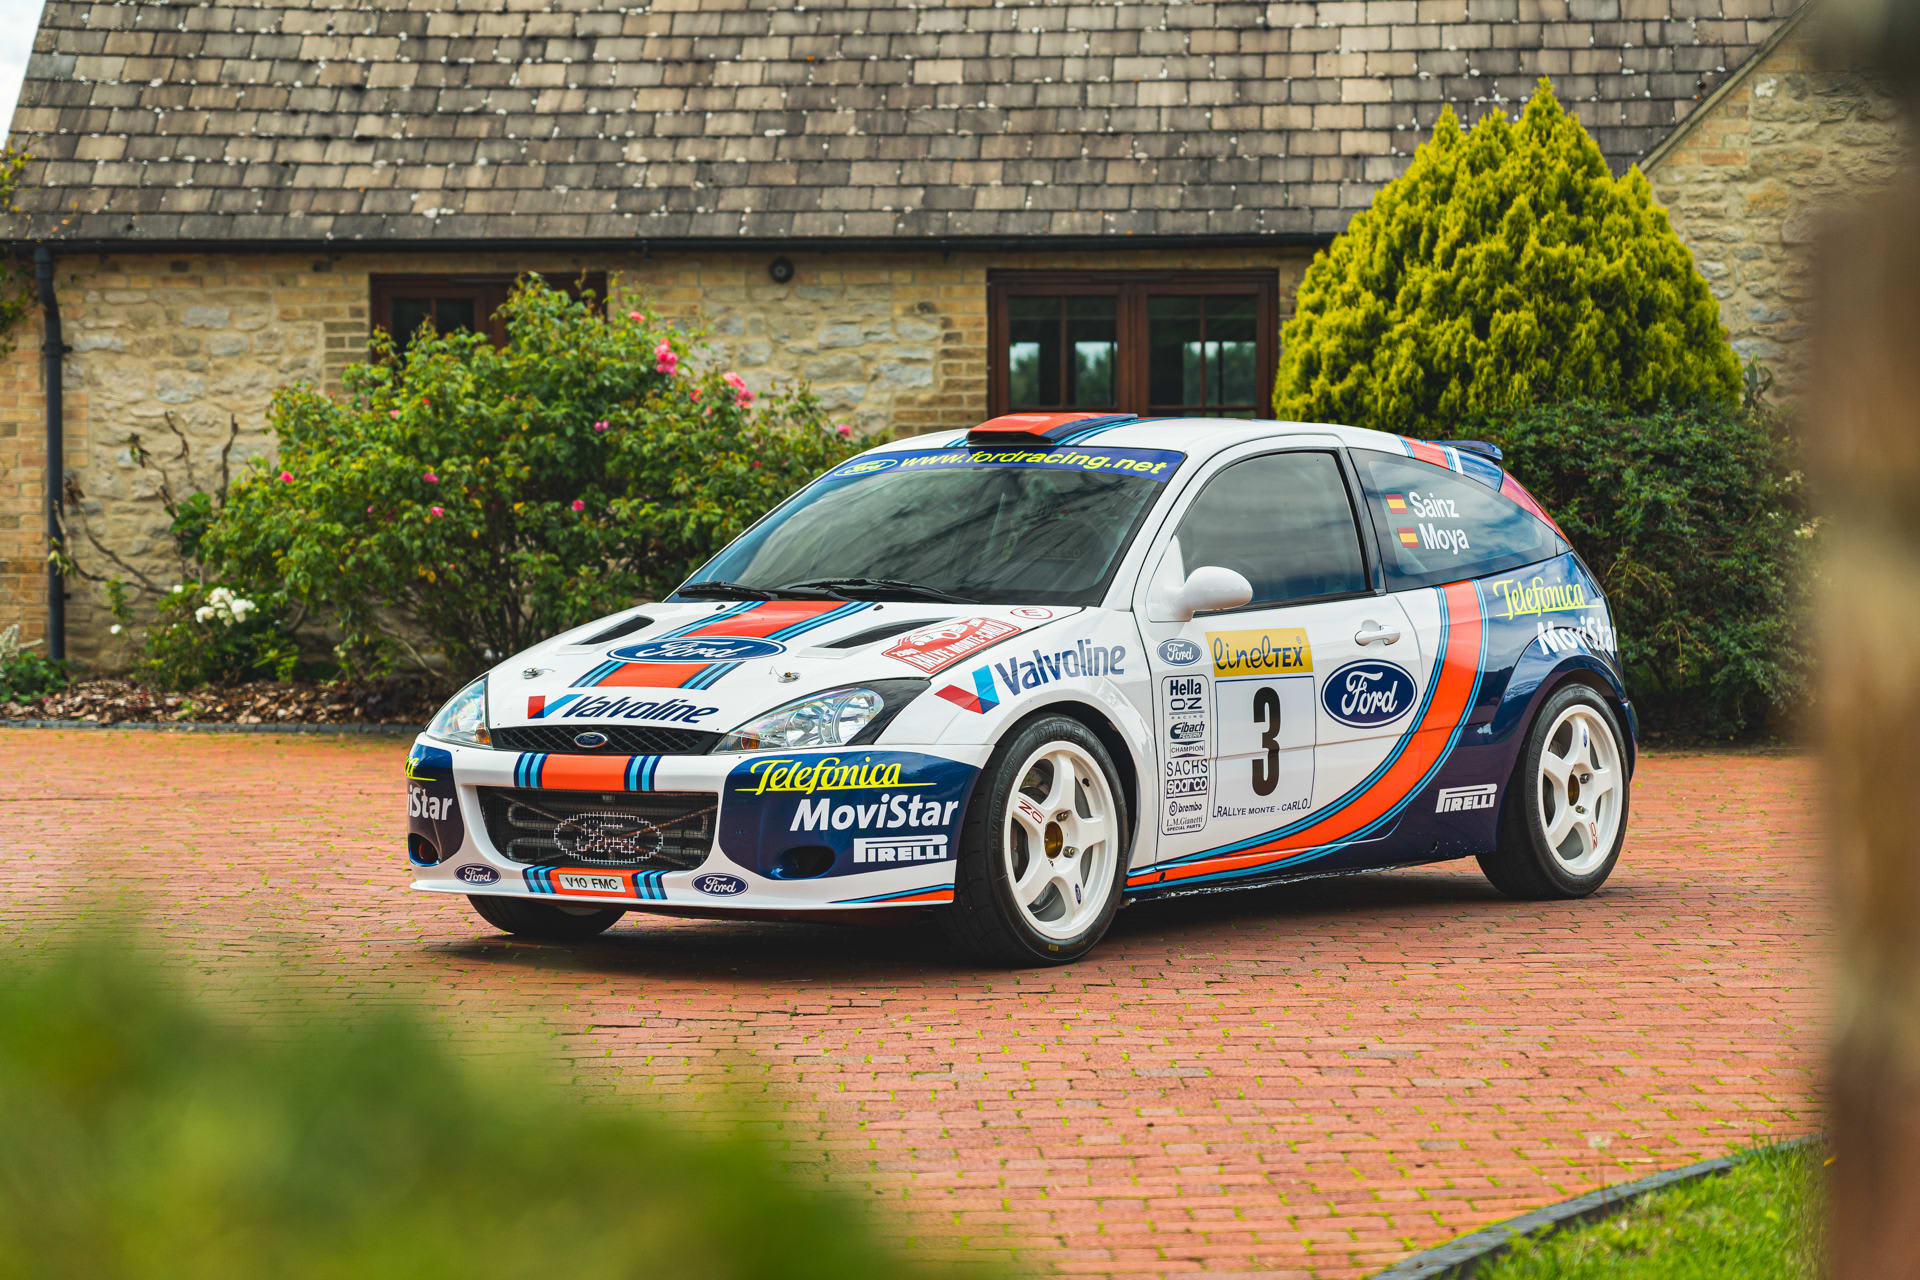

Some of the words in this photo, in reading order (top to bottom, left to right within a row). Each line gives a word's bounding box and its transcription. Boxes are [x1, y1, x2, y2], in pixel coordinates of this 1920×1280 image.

[900, 450, 1167, 474] www.fordracing.net
[1408, 491, 1460, 518] Sainz
[1418, 523, 1470, 555] Moya
[635, 640, 755, 658] Ford
[1166, 643, 1194, 661] Ford
[994, 638, 1126, 696] Valvoline
[1170, 679, 1202, 696] Hella
[1341, 671, 1398, 716] Ford
[561, 695, 719, 724] Valvoline
[1170, 720, 1205, 740] Eibach
[1171, 745, 1204, 754] CHAMPION
[1251, 687, 1281, 797] 3
[1166, 759, 1208, 777] SACHS
[1167, 777, 1207, 798] sparco
[1435, 783, 1498, 813] PIRELLI
[407, 784, 453, 821] iStar
[789, 793, 959, 832] MoviStar
[1178, 801, 1203, 812] brembo
[1216, 805, 1246, 818] RALLYE
[1248, 805, 1276, 815] MONTE
[1281, 798, 1309, 812] CARLO
[853, 834, 949, 863] PIRELLI
[464, 865, 492, 882] Ford
[565, 877, 587, 889] V10
[591, 878, 618, 890] FMC
[703, 876, 737, 894] Ford
